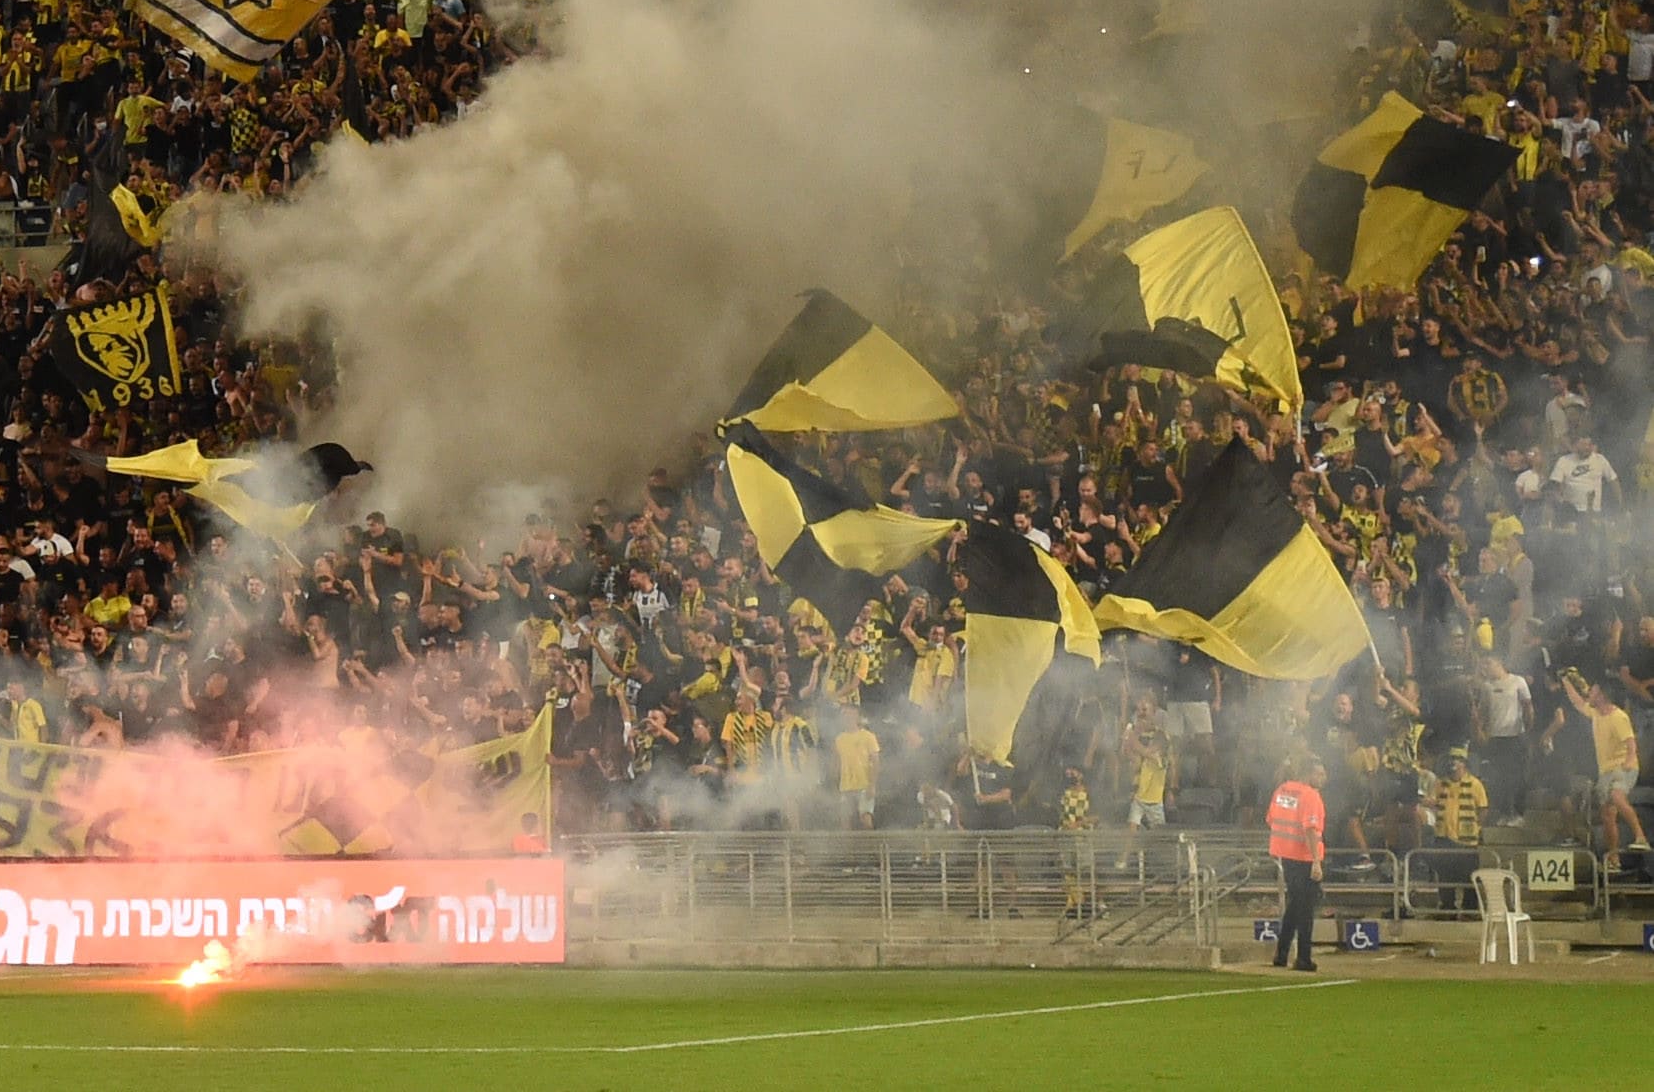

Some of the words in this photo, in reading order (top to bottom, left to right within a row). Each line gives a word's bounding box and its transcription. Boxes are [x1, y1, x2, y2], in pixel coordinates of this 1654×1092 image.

[88, 375, 175, 412] 1936
[1531, 859, 1571, 883] A24
[102, 897, 228, 938] השכרת
[438, 886, 557, 944] שלמה
